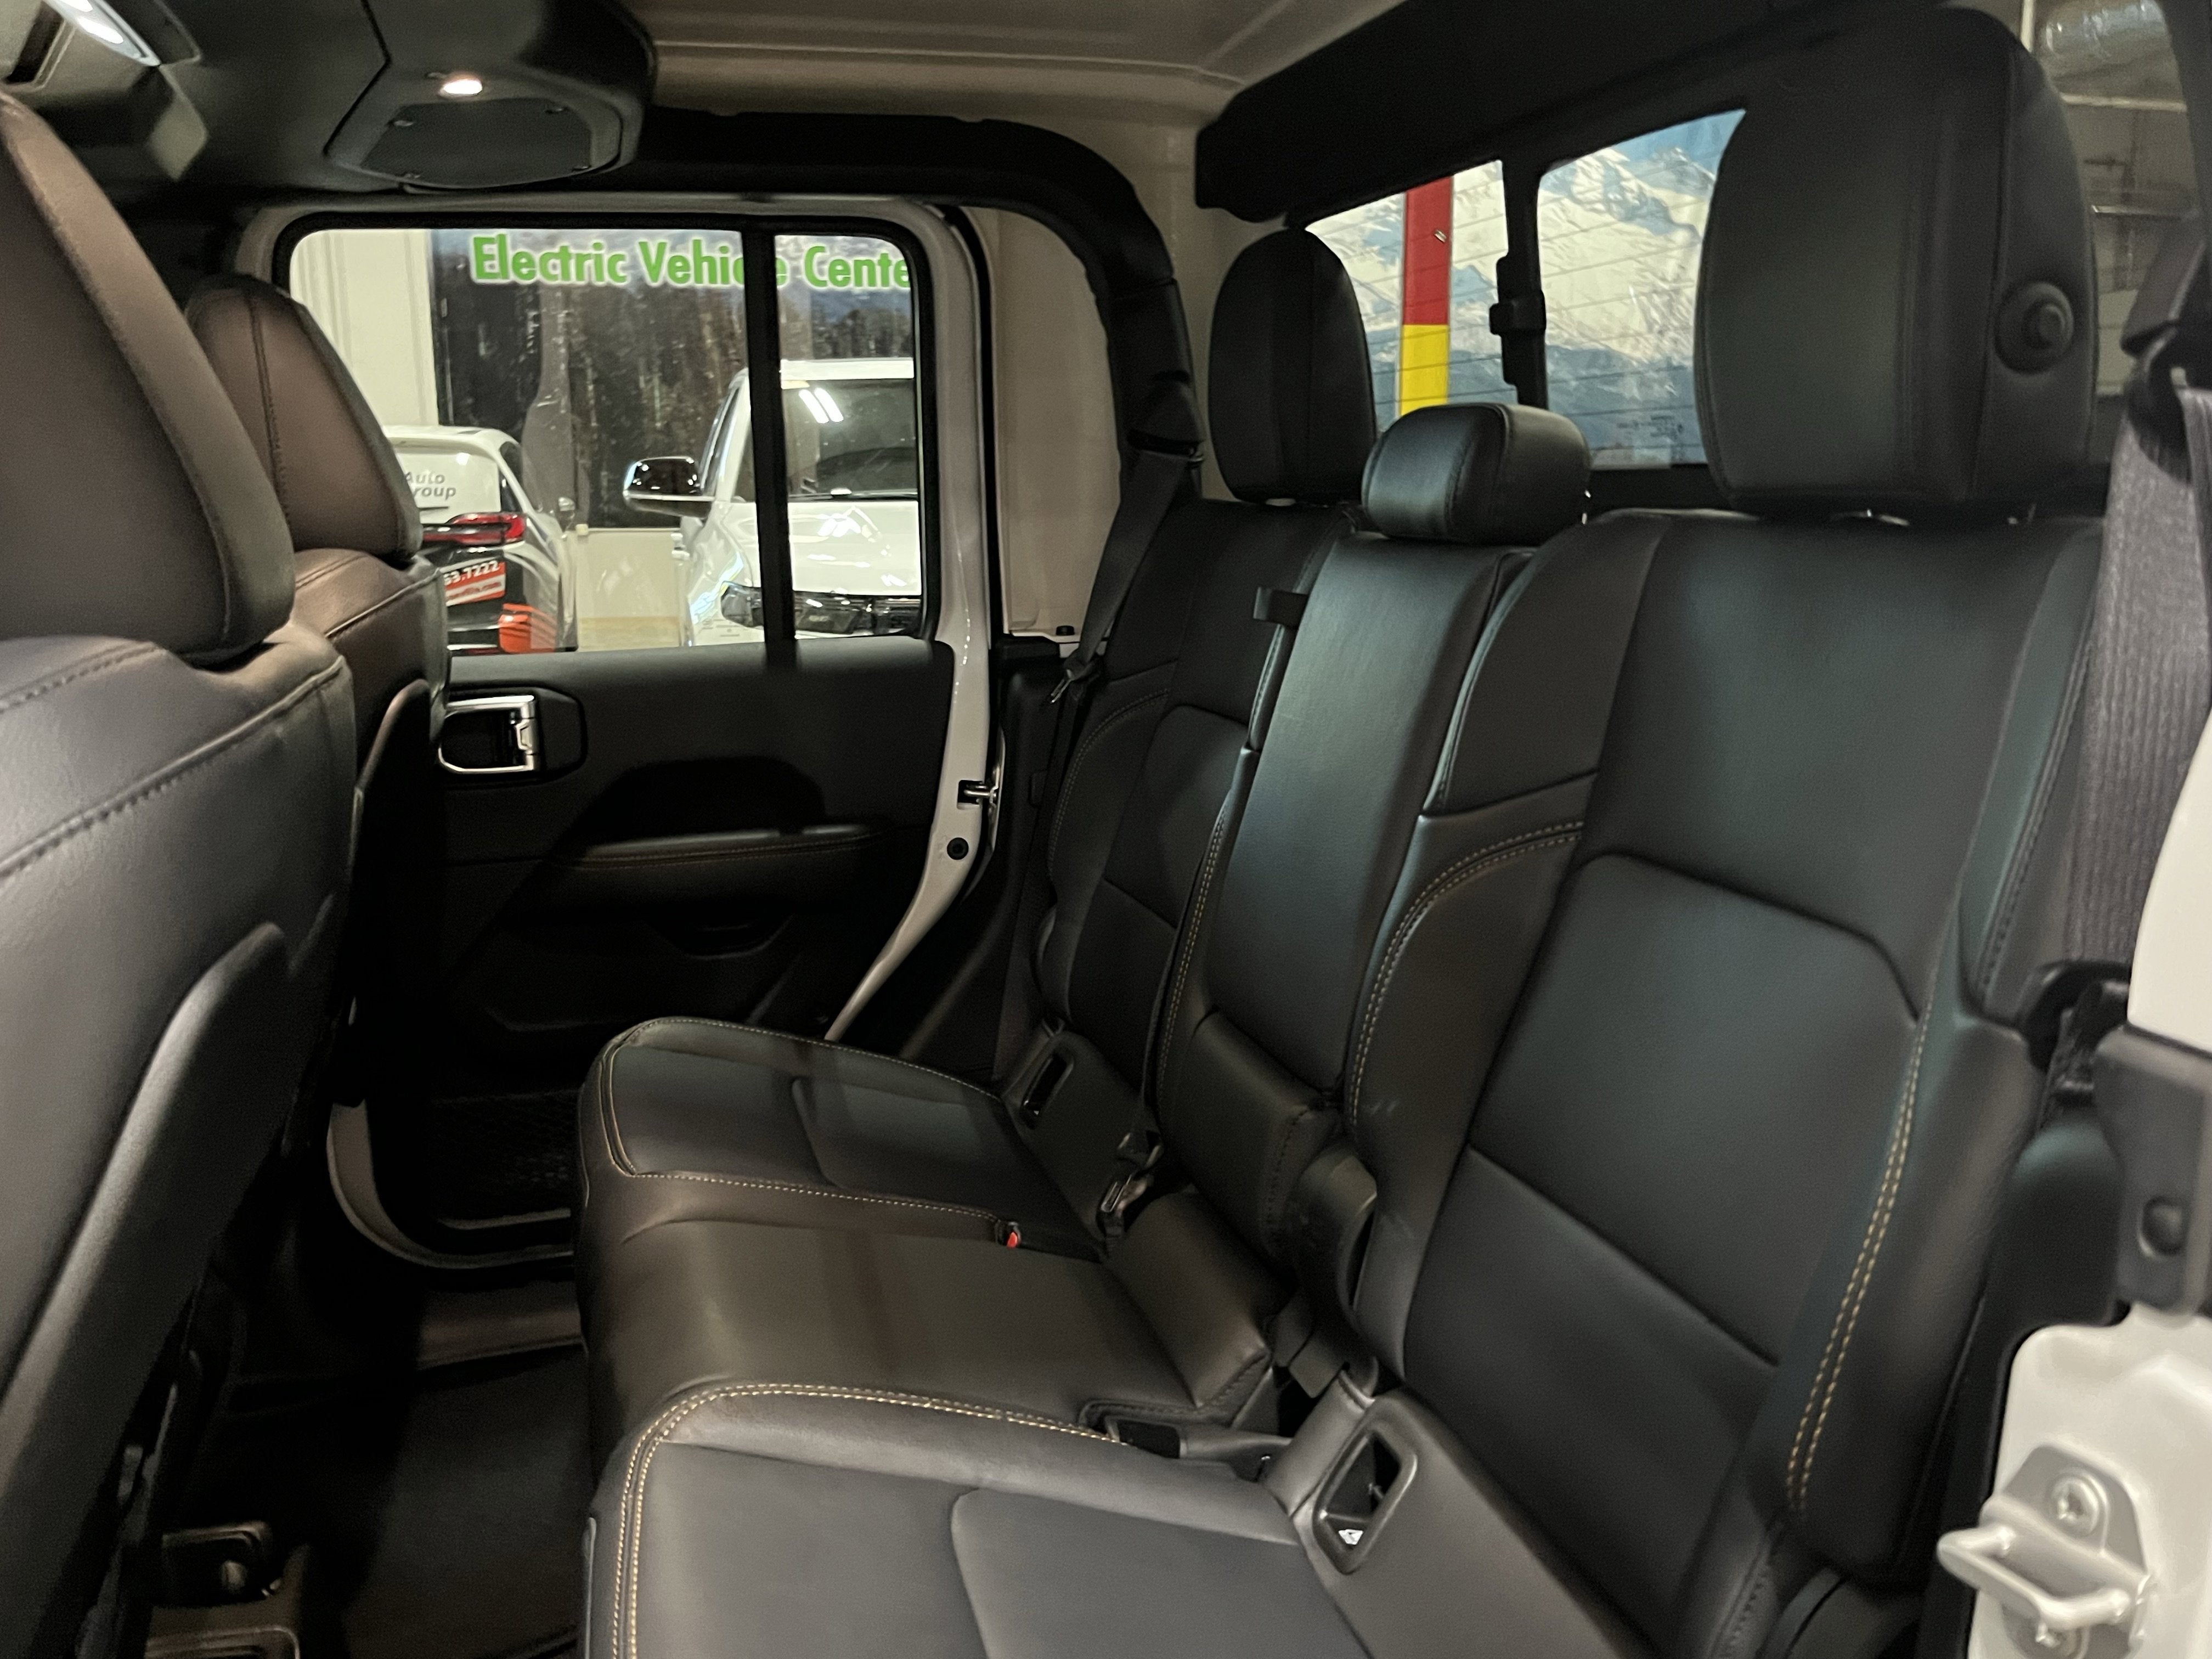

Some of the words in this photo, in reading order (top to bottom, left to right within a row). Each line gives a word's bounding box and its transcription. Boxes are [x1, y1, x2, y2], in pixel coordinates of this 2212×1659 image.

[473, 233, 628, 284] Electric
[637, 240, 787, 286] Vehice
[804, 246, 911, 287] Cente
[413, 487, 456, 500] roup
